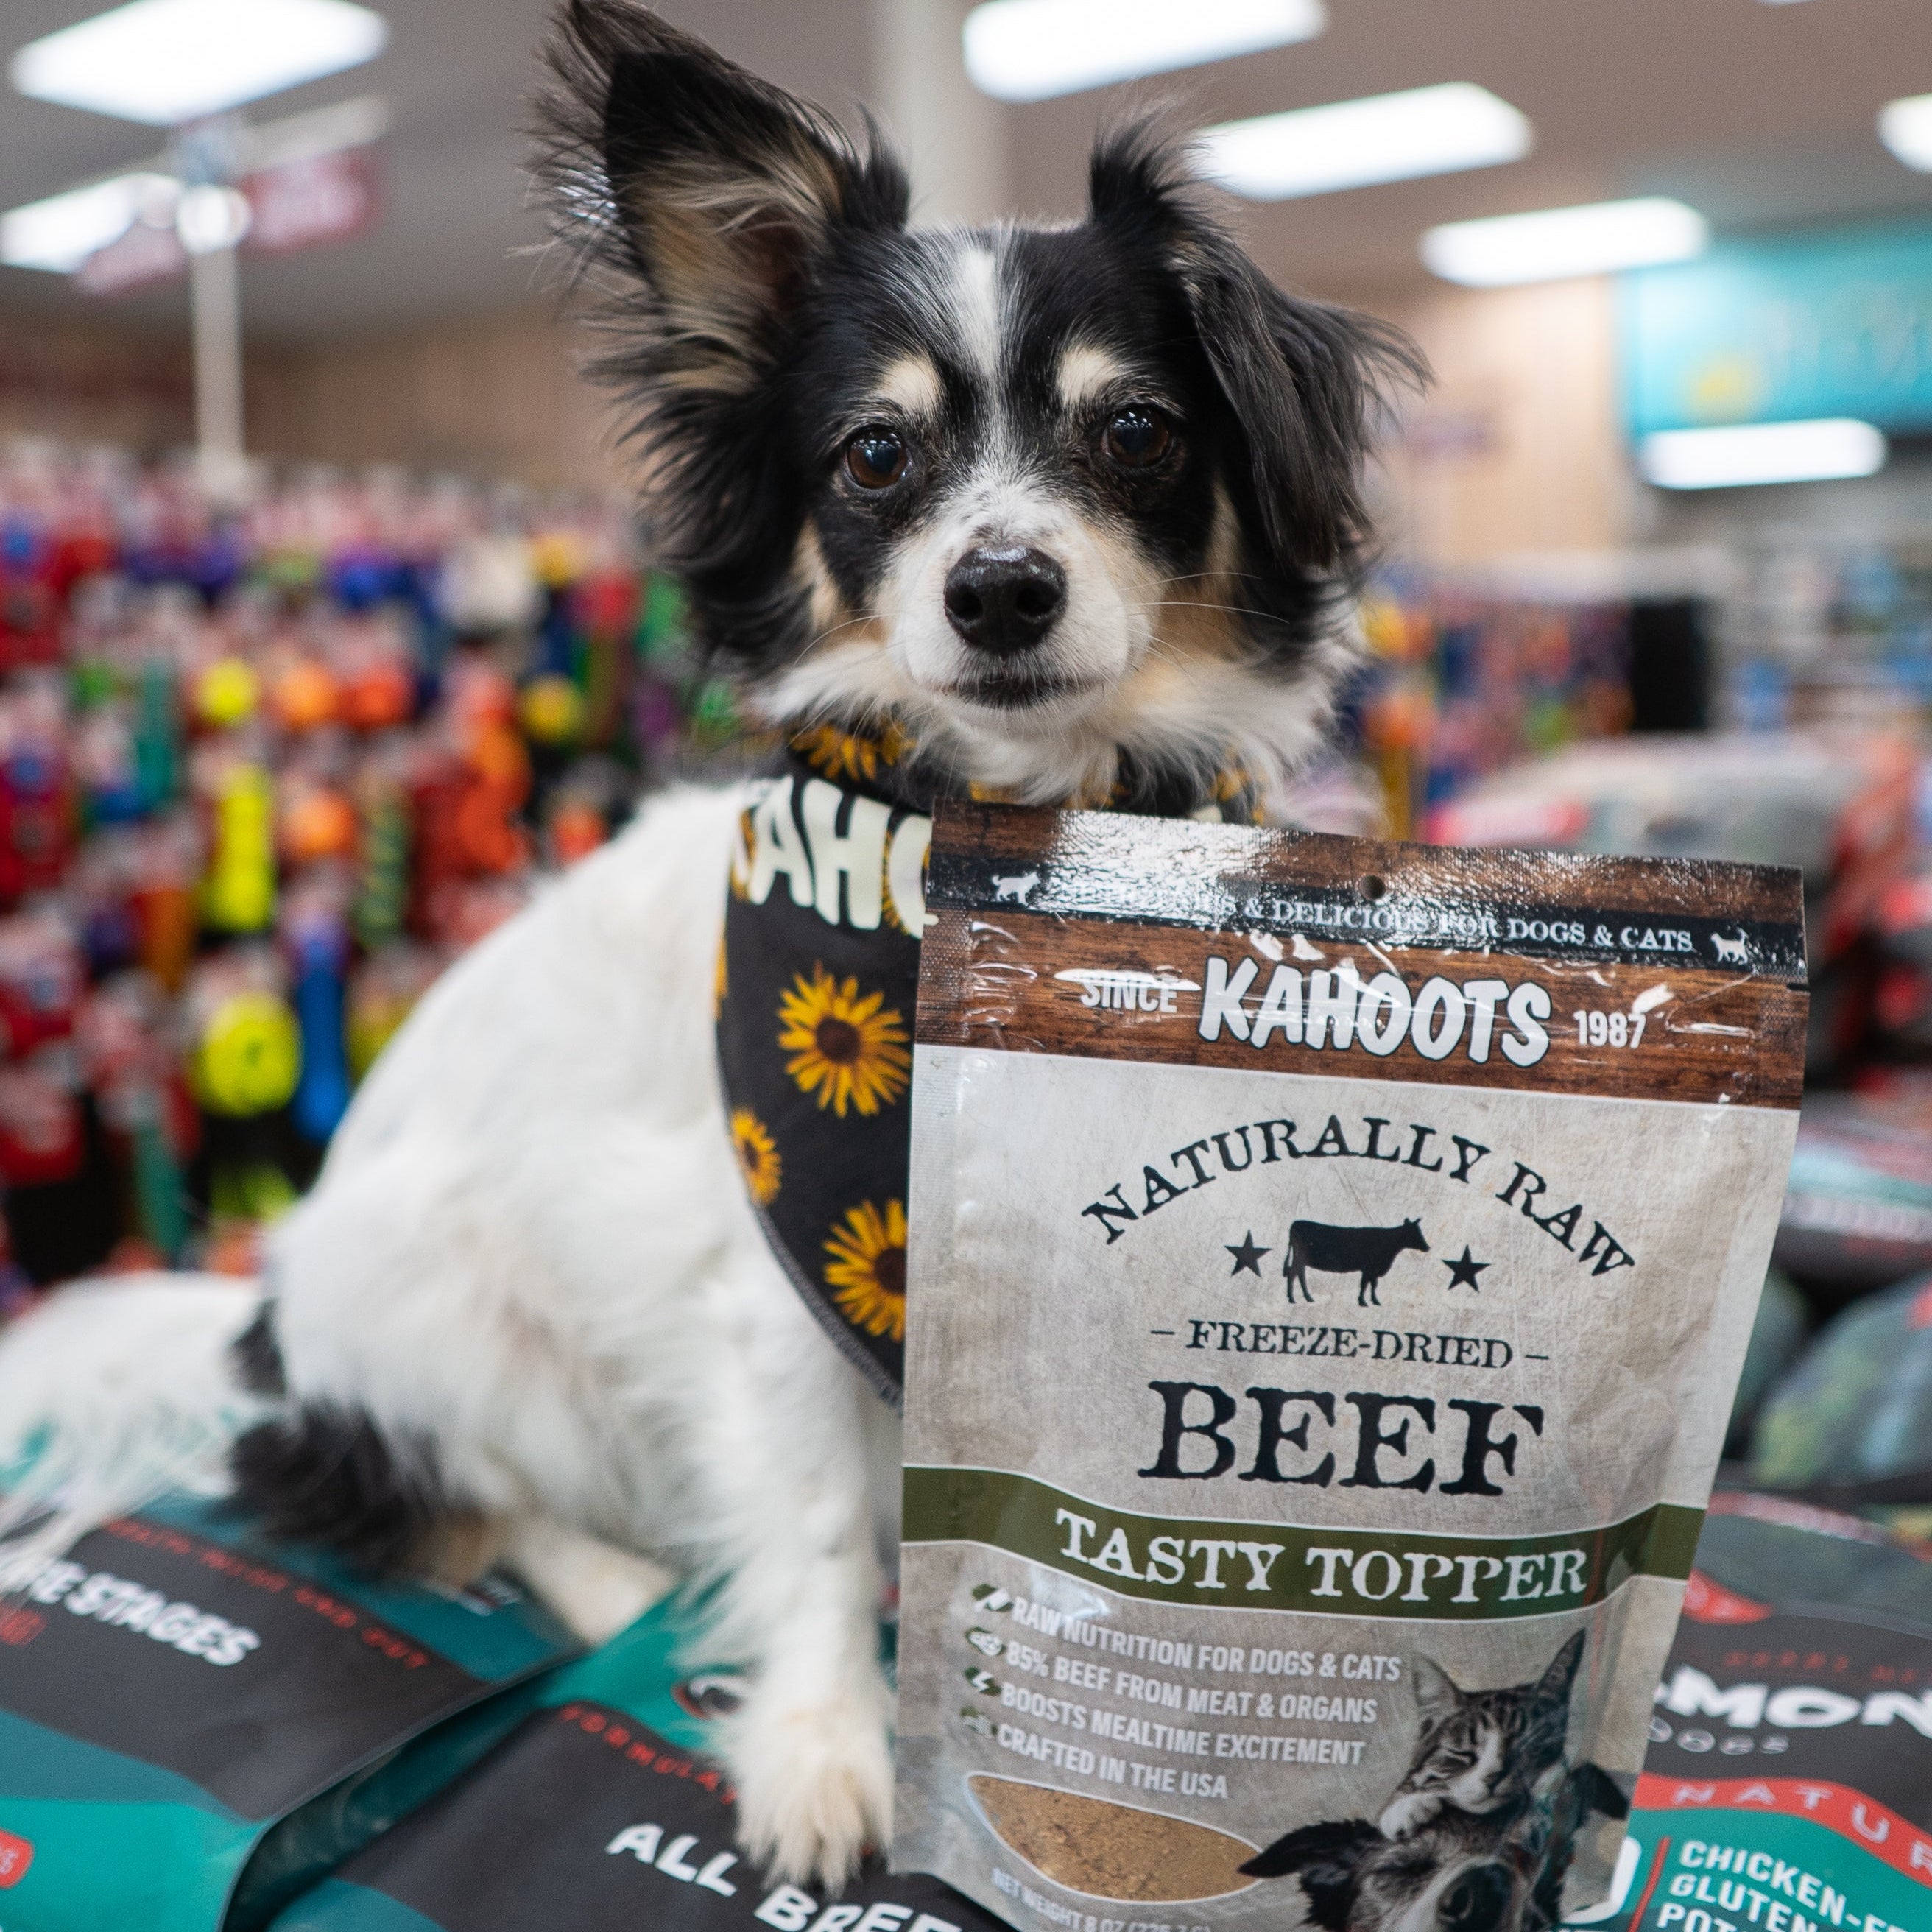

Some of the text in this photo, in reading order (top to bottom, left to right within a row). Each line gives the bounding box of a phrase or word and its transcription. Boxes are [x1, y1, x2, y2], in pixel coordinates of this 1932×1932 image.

[1275, 898, 1427, 933] DELICIOUS
[1439, 914, 1500, 939] FOR
[1509, 916, 1585, 945] DOGS
[1593, 925, 1613, 948] &
[1620, 926, 1693, 953] CATS
[1079, 956, 1648, 1068] SINCE KAHOOTS 1987
[1082, 1115, 1636, 1277] NATURALLY RAW
[1185, 1319, 1514, 1369] FREEZE-DRIED
[1138, 1381, 1544, 1496] BEEF
[1054, 1508, 1587, 1604] TASTY TOPPER
[64, 1572, 261, 1666] STAGES
[1012, 1596, 1403, 1682] RAW NUTRITION FOR DOGS & CATS
[1001, 1682, 1367, 1766] BOOSTS MEALTIME EXCITEMENT
[1006, 1640, 1378, 1724] 85% BEEF FROM MEAT & ORGANS
[1654, 1663, 1932, 1741] MON
[998, 1722, 1229, 1799] CRAFTED IN THE USA
[604, 1822, 738, 1898] ALL
[991, 1867, 1022, 1897] NET
[1022, 1885, 1083, 1931] WEIGHT
[1085, 1915, 1097, 1932] 8
